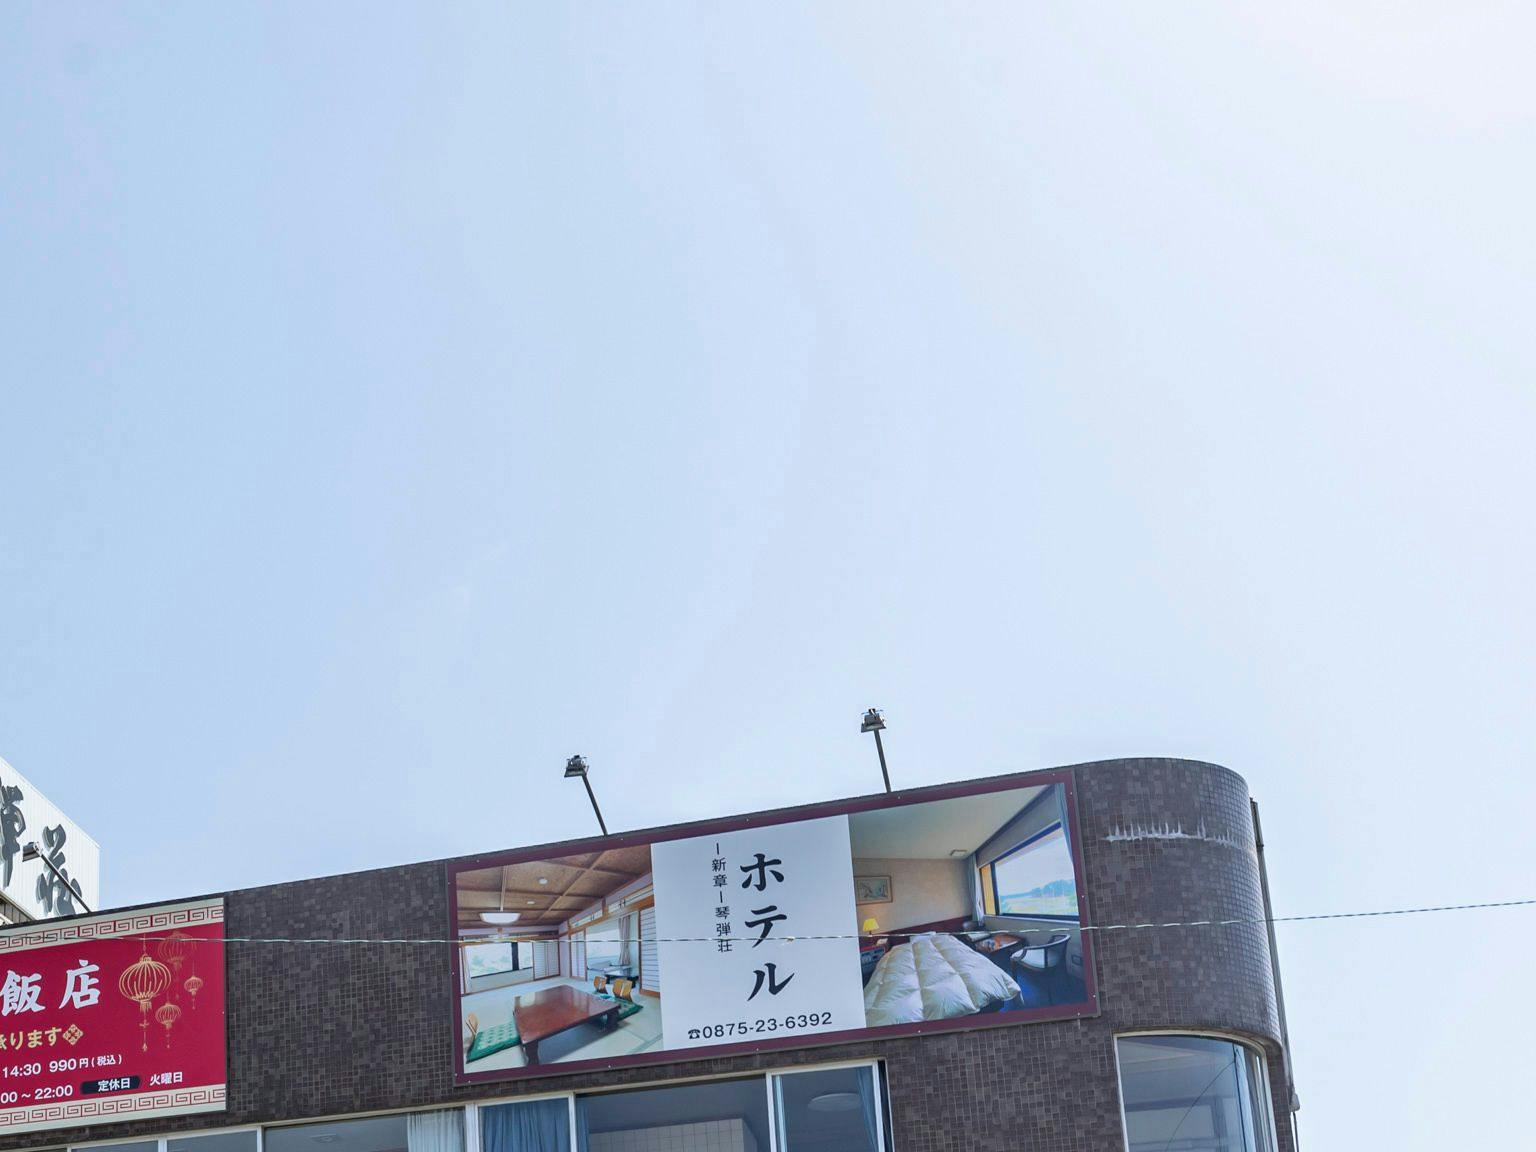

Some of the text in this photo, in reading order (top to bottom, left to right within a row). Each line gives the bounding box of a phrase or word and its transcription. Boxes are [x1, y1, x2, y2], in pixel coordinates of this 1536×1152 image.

[739, 853, 795, 1002] ホテル
[702, 1011, 833, 1040] 0875-23-6392
[2, 1062, 42, 1079] 14:30
[34, 1084, 73, 1100] 22:00
[97, 1077, 131, 1092] 定休日
[149, 1071, 184, 1086] 火曜日
